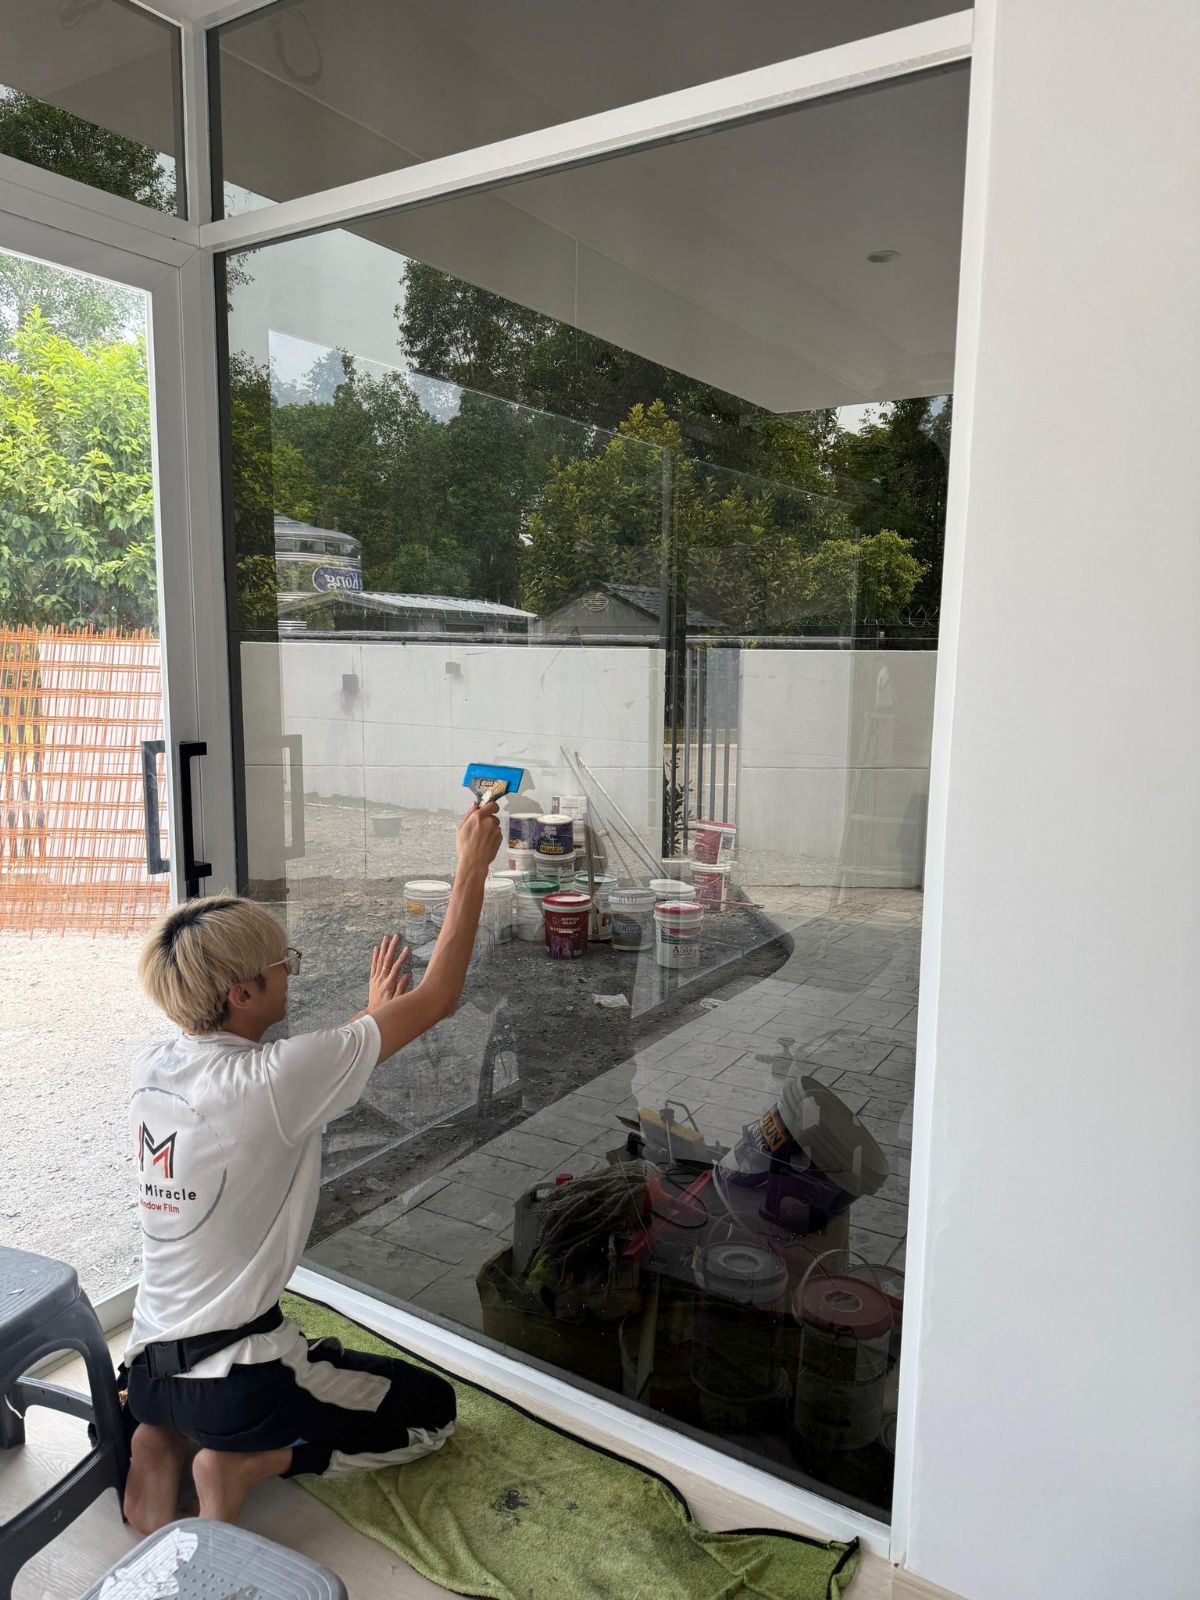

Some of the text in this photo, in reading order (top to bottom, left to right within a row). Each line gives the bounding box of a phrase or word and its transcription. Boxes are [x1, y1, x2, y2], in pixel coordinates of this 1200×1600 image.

[145, 1183, 197, 1200] Miracle
[140, 1199, 180, 1213] indow Film
